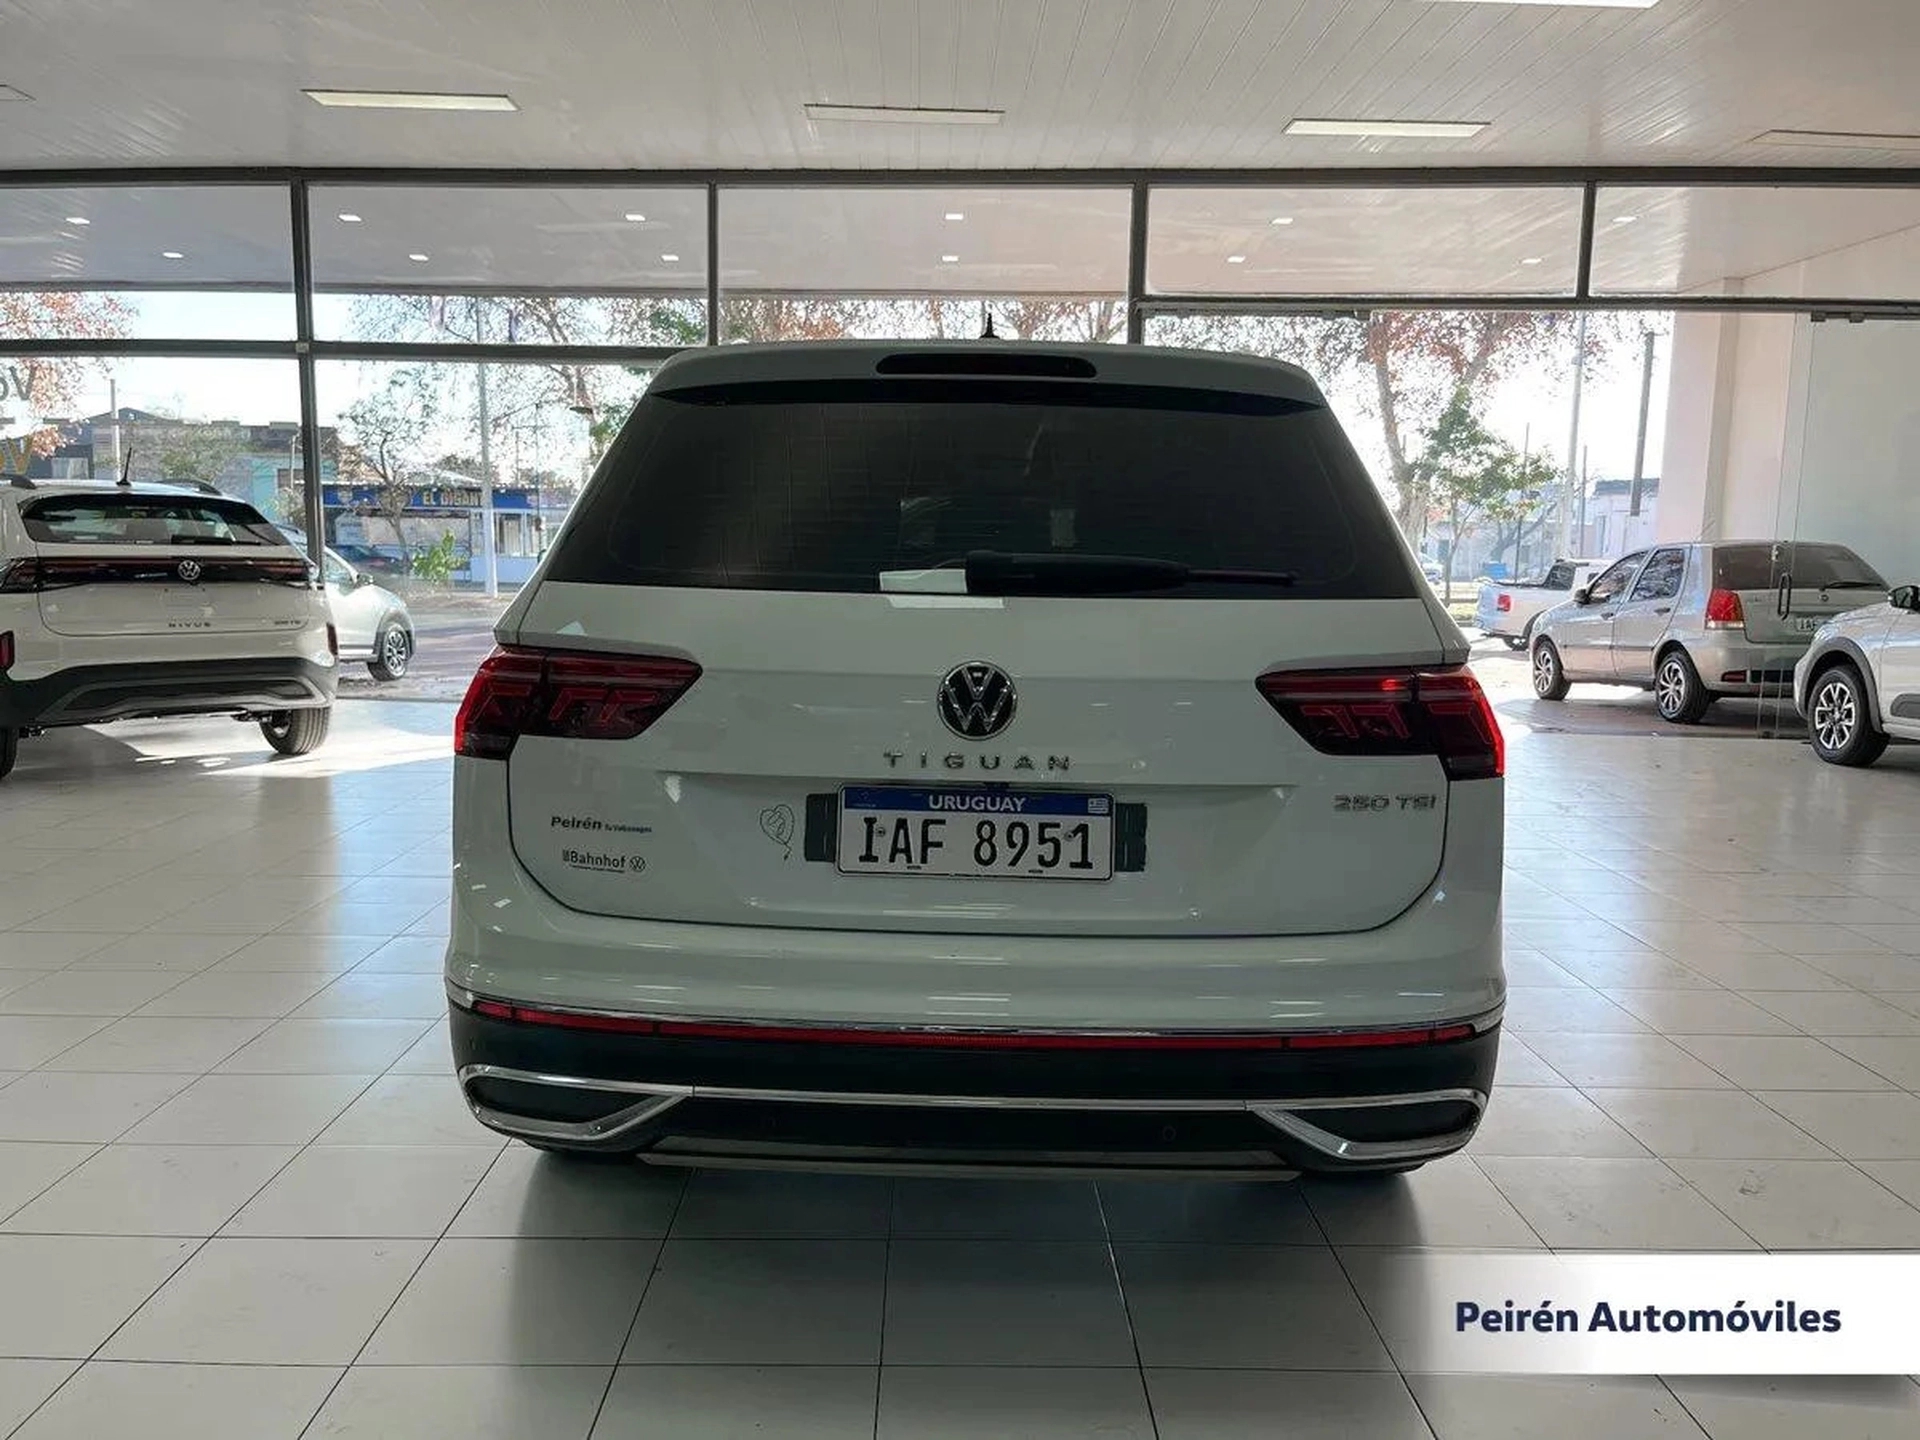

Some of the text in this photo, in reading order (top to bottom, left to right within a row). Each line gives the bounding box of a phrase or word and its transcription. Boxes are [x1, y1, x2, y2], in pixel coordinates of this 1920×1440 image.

[883, 752, 1070, 770] TIGUAN
[928, 795, 1026, 812] URUGUAY
[1334, 794, 1436, 811] 250 TSI
[551, 816, 602, 830] Peirén
[859, 817, 1093, 869] IAF 8951
[570, 850, 625, 868] Bahnhof
